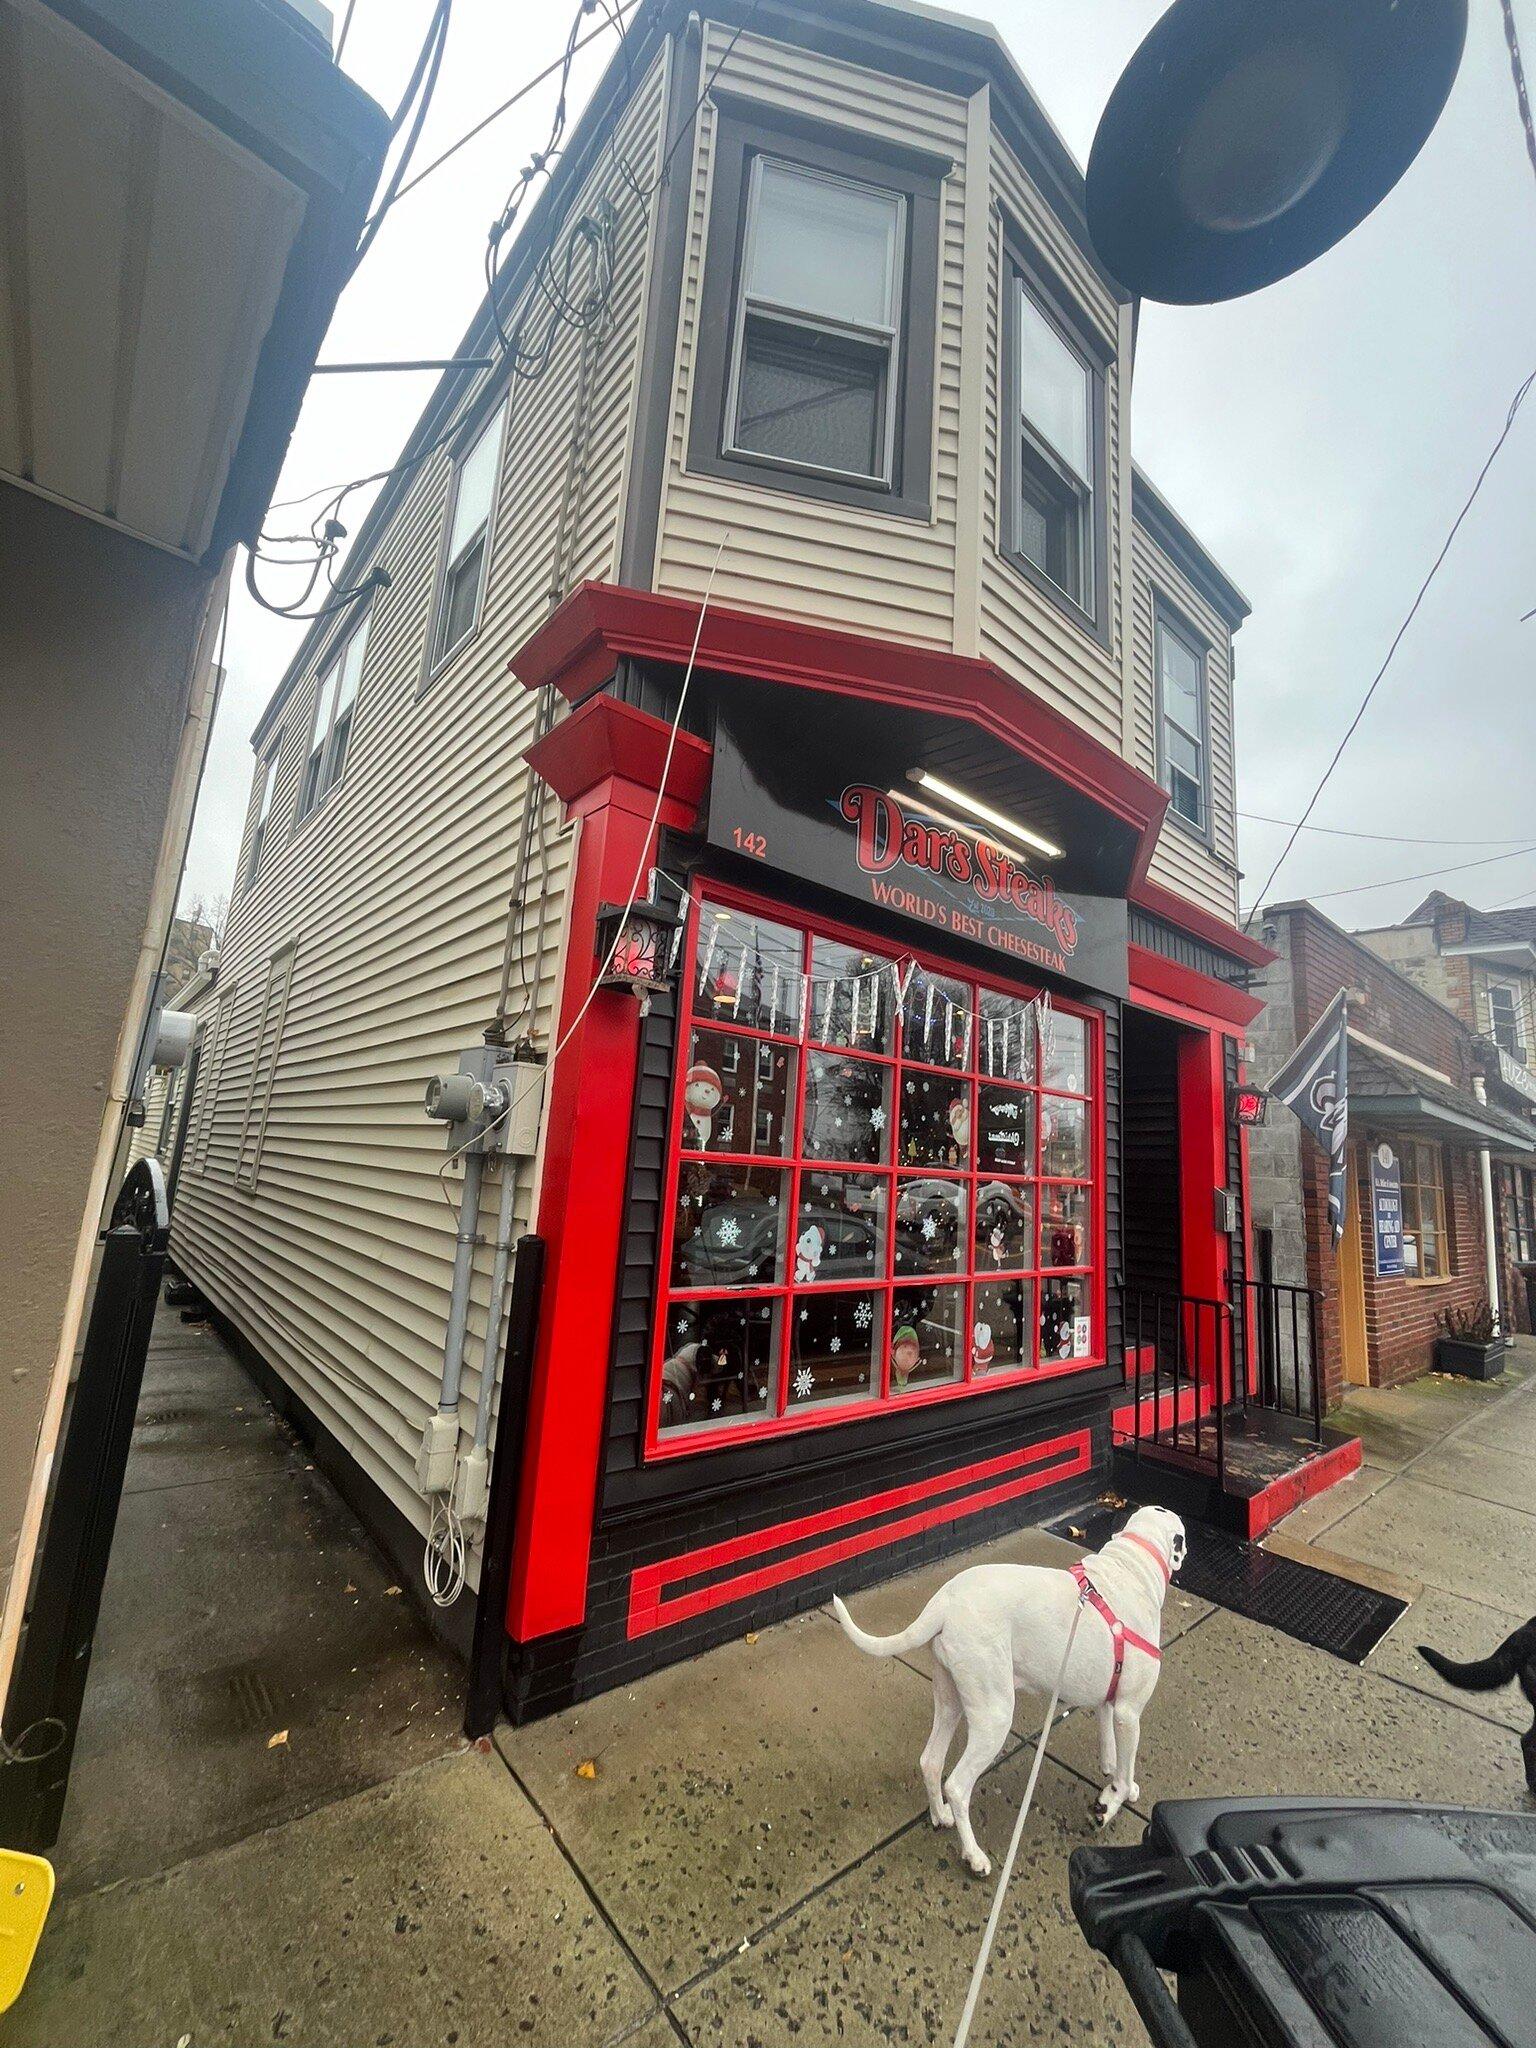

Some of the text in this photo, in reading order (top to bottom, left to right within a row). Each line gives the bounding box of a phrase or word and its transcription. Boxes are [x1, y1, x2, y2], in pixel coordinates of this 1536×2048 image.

[733, 826, 768, 858] 142
[840, 784, 1079, 955] Dar's Steaks
[871, 878, 1067, 973] WORLD'S BEST CHEESESTEAK
